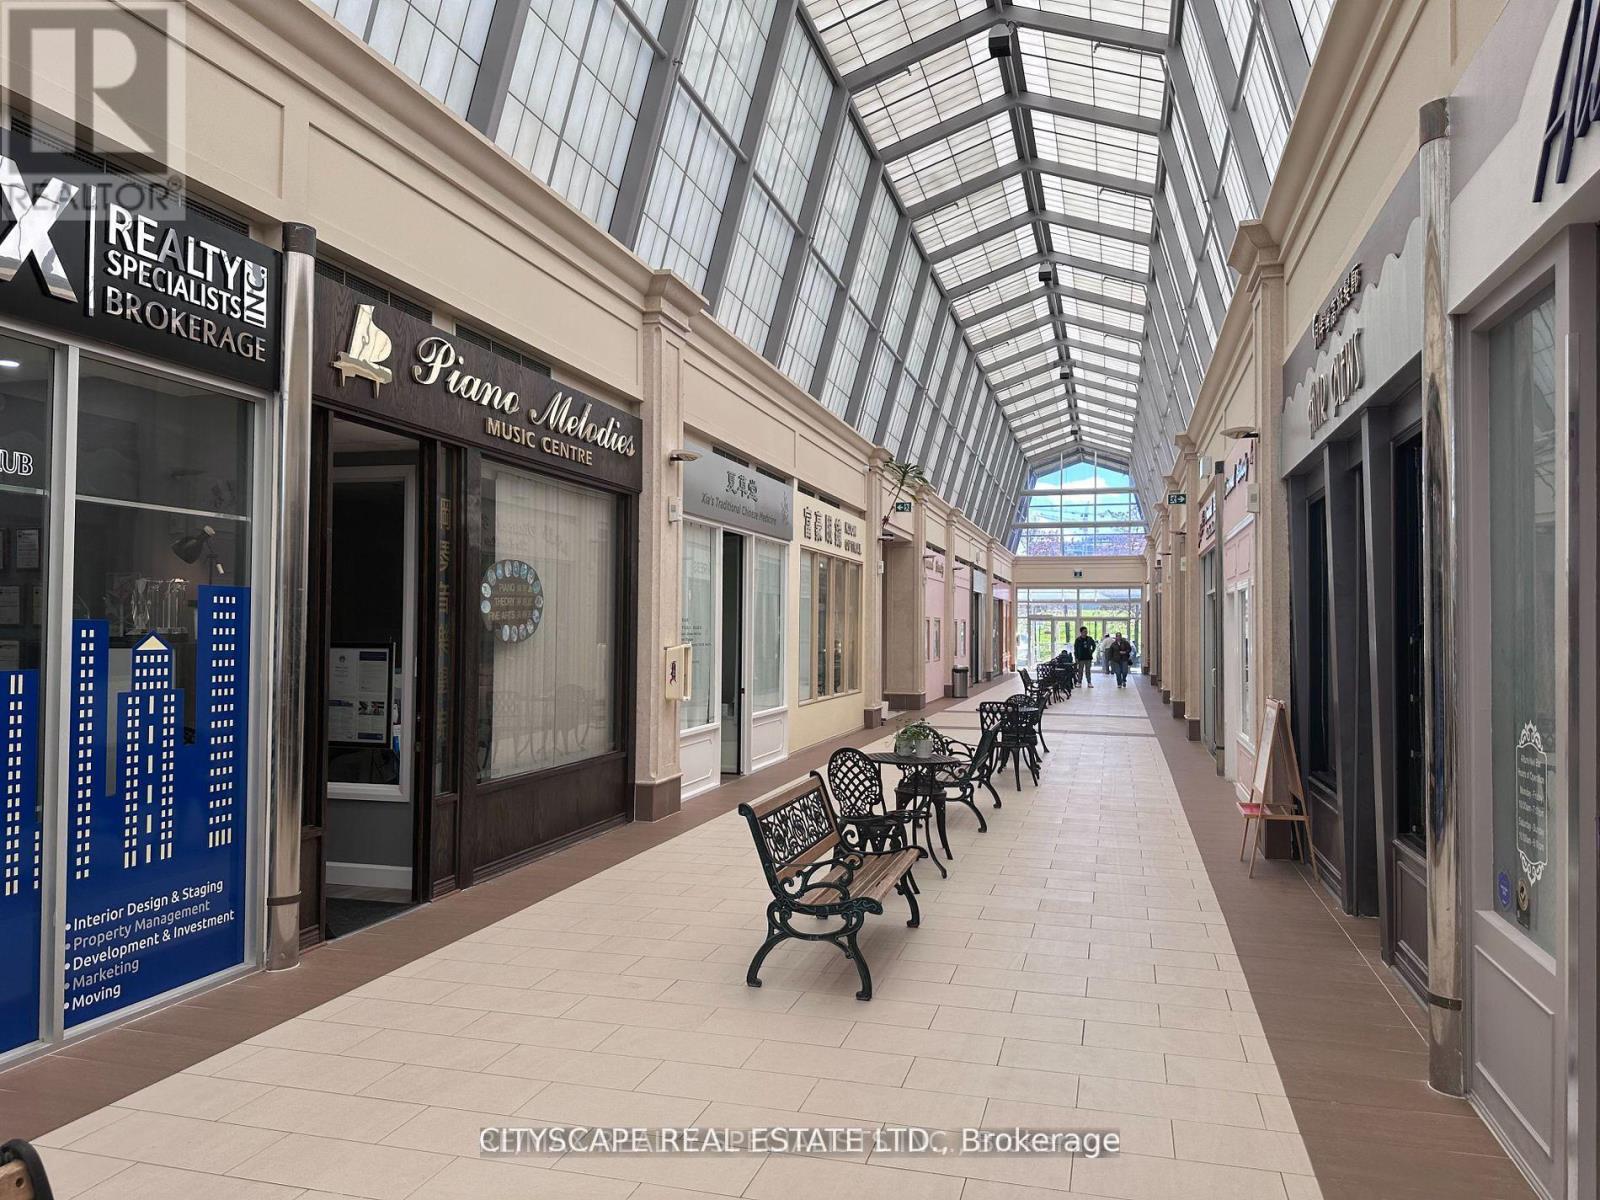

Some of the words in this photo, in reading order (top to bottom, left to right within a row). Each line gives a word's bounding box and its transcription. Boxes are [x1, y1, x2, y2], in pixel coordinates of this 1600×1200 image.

[108, 203, 243, 291] REALTY
[106, 250, 242, 320] SPECIALISTS
[245, 268, 266, 325] INC.
[105, 286, 267, 362] BROKERAGE
[411, 336, 520, 414] Piano
[527, 391, 636, 457] Melodies
[0, 449, 34, 476] UB
[485, 417, 536, 449] MUSIC
[541, 437, 593, 466] CENTRE
[715, 496, 741, 514] Traditional
[742, 506, 759, 521] Chinese
[74, 906, 124, 932] Interior
[127, 895, 169, 917] Design
[171, 890, 180, 903] &
[182, 879, 224, 901] Staging
[74, 924, 132, 951] Property
[134, 899, 211, 933] Management
[73, 933, 160, 971] Development
[162, 929, 171, 942] &
[173, 910, 235, 938] Investment
[72, 958, 139, 990] Marketing
[72, 983, 121, 1011] Moving
